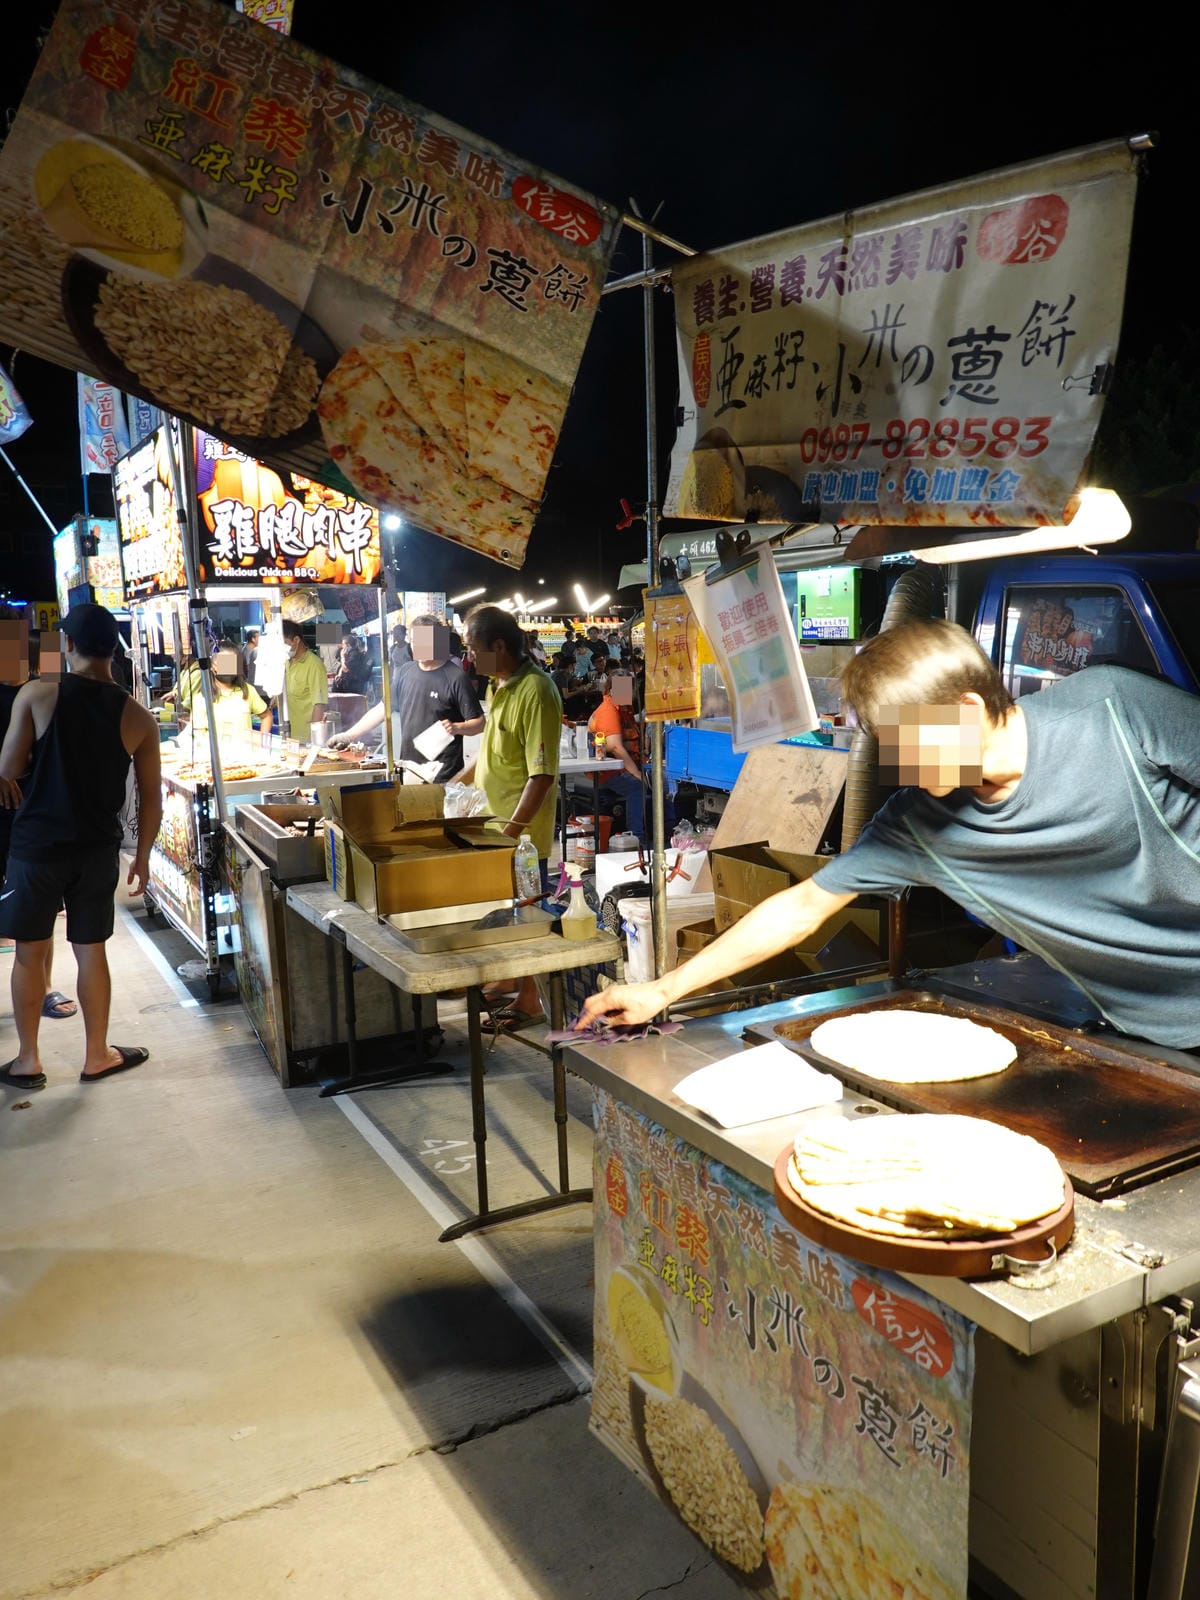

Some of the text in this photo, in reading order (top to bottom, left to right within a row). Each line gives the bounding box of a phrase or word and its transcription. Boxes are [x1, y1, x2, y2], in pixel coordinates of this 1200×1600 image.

[519, 186, 590, 243] 信谷
[800, 416, 1052, 464] 0987-828583
[208, 500, 373, 575] 雞腿肉串
[215, 567, 257, 577] Delicious
[259, 567, 293, 577] Chicken
[717, 592, 769, 631] 歡迎使用
[863, 1291, 943, 1376] 信谷
